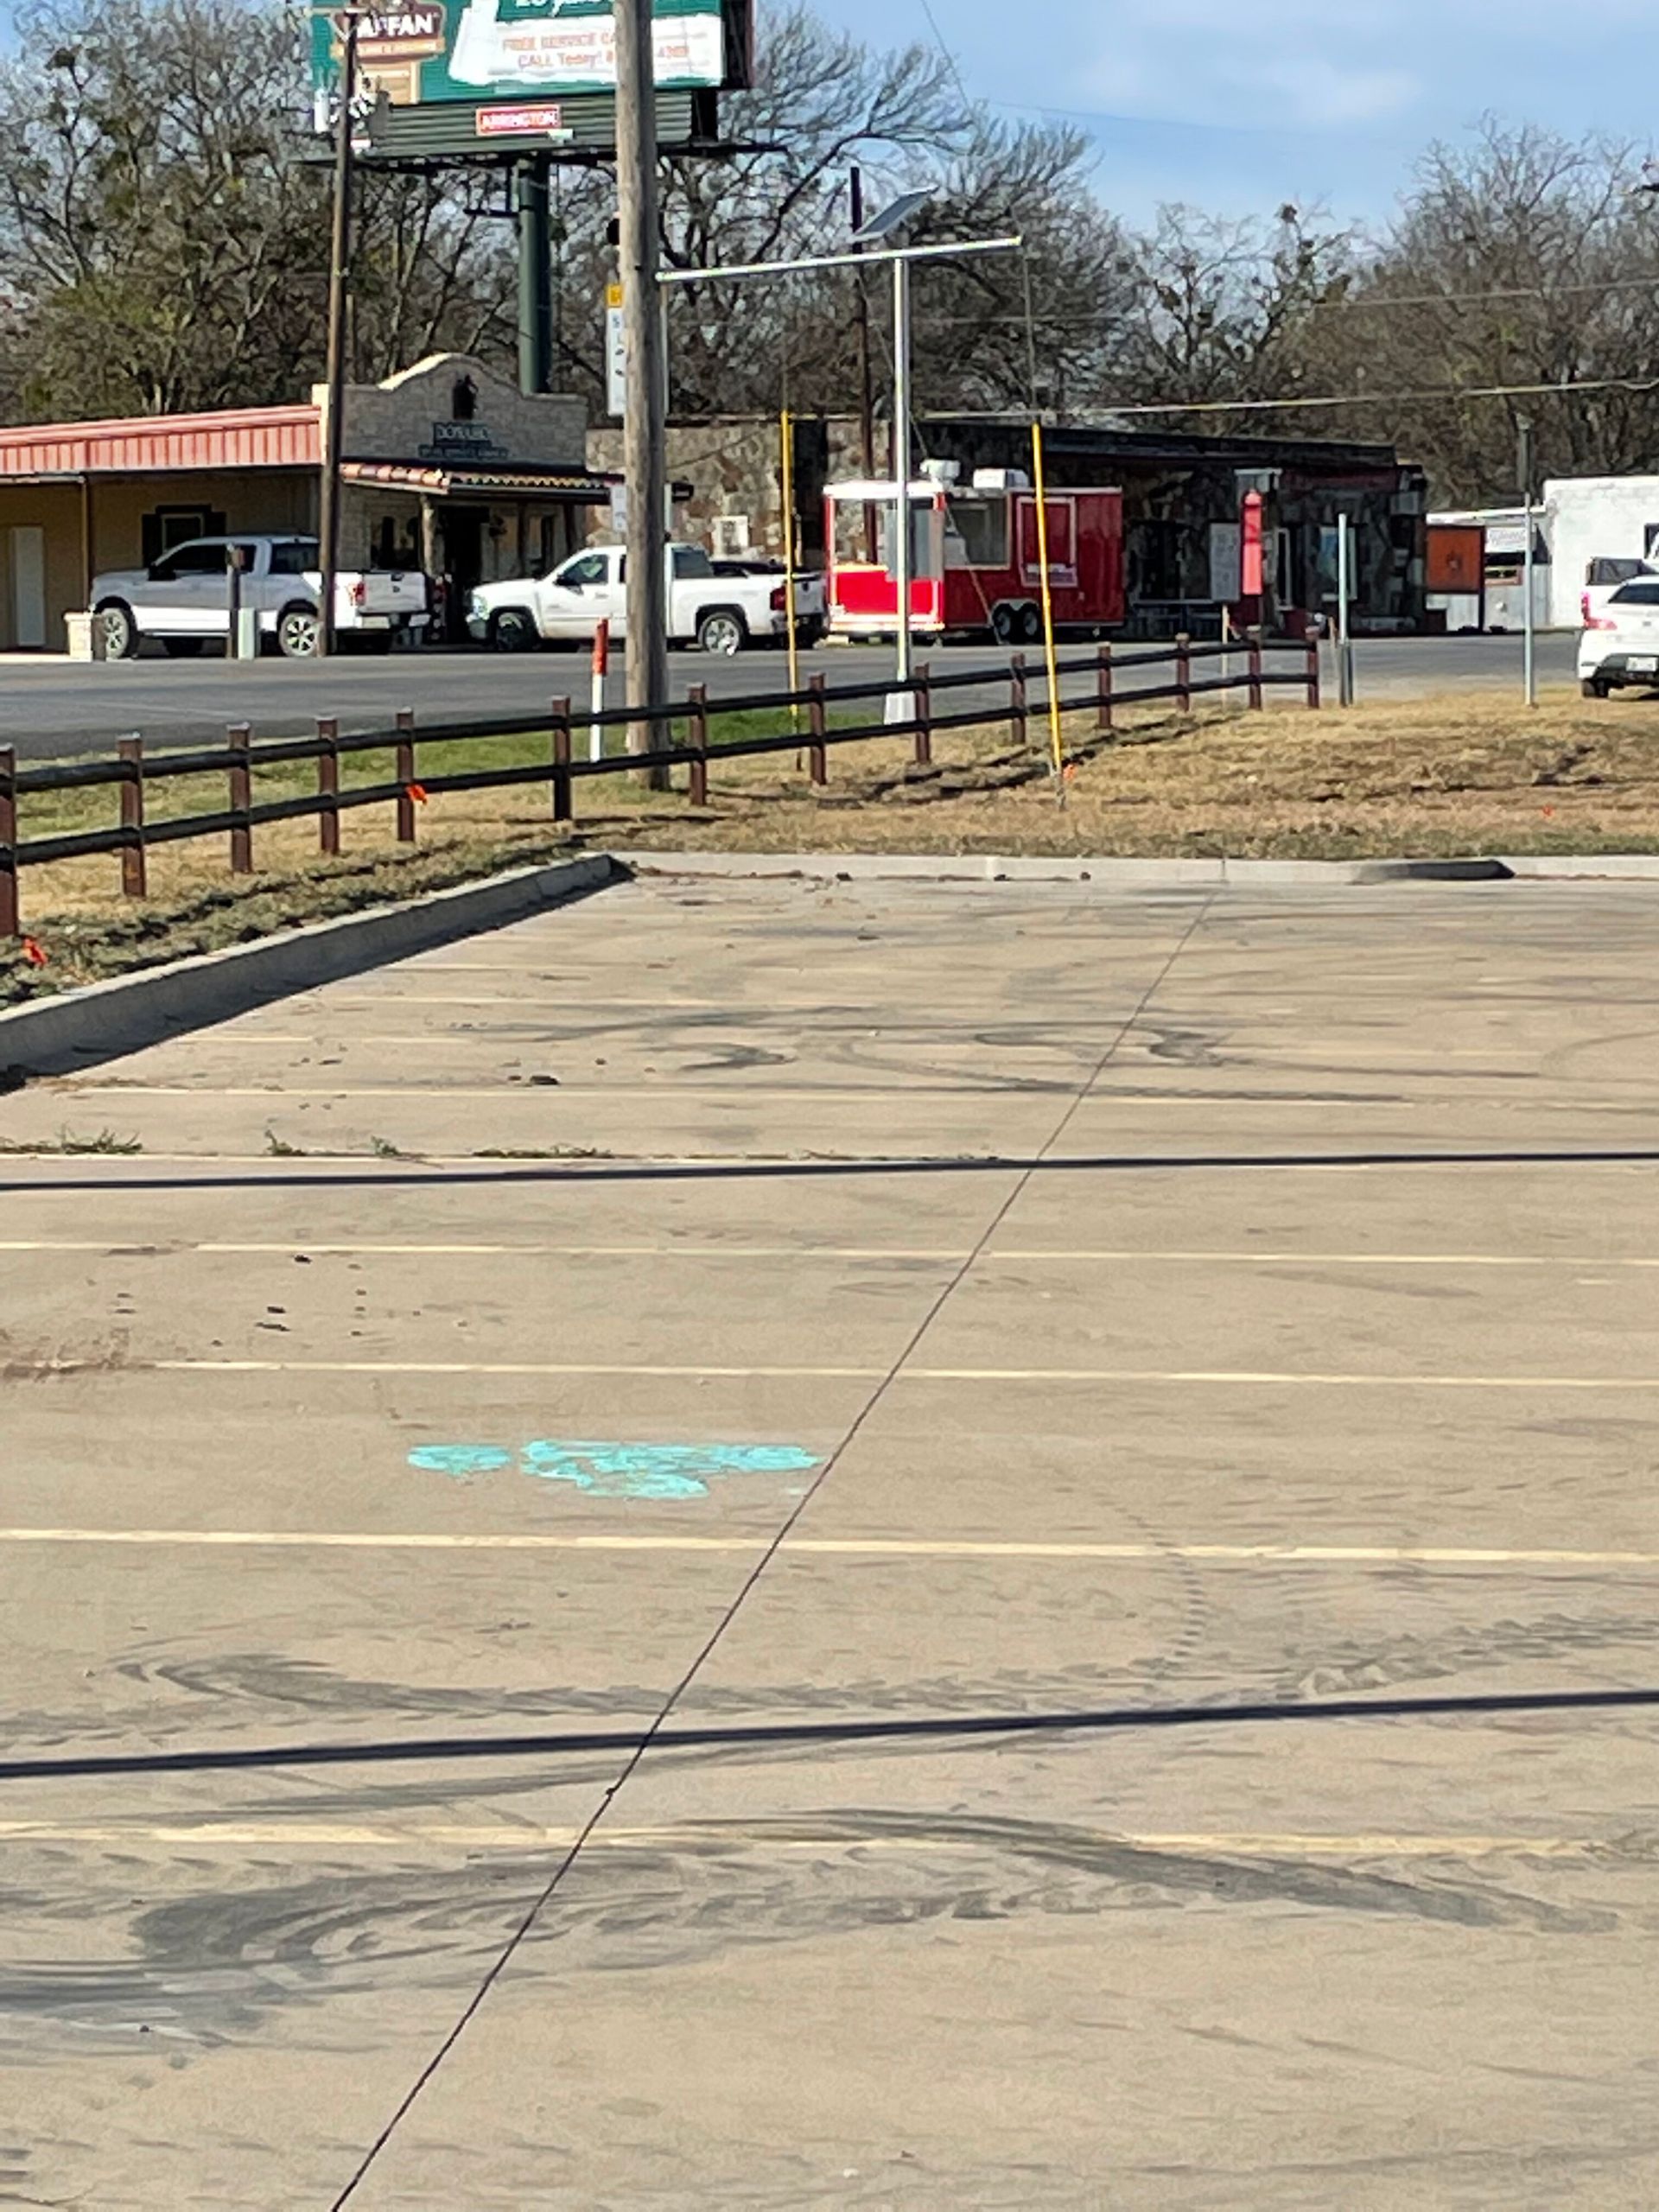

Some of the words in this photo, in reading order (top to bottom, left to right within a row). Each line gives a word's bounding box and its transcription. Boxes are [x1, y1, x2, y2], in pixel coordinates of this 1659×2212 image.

[503, 37, 536, 51] FREE
[540, 33, 596, 48] SERVICE
[518, 52, 554, 68] CALL
